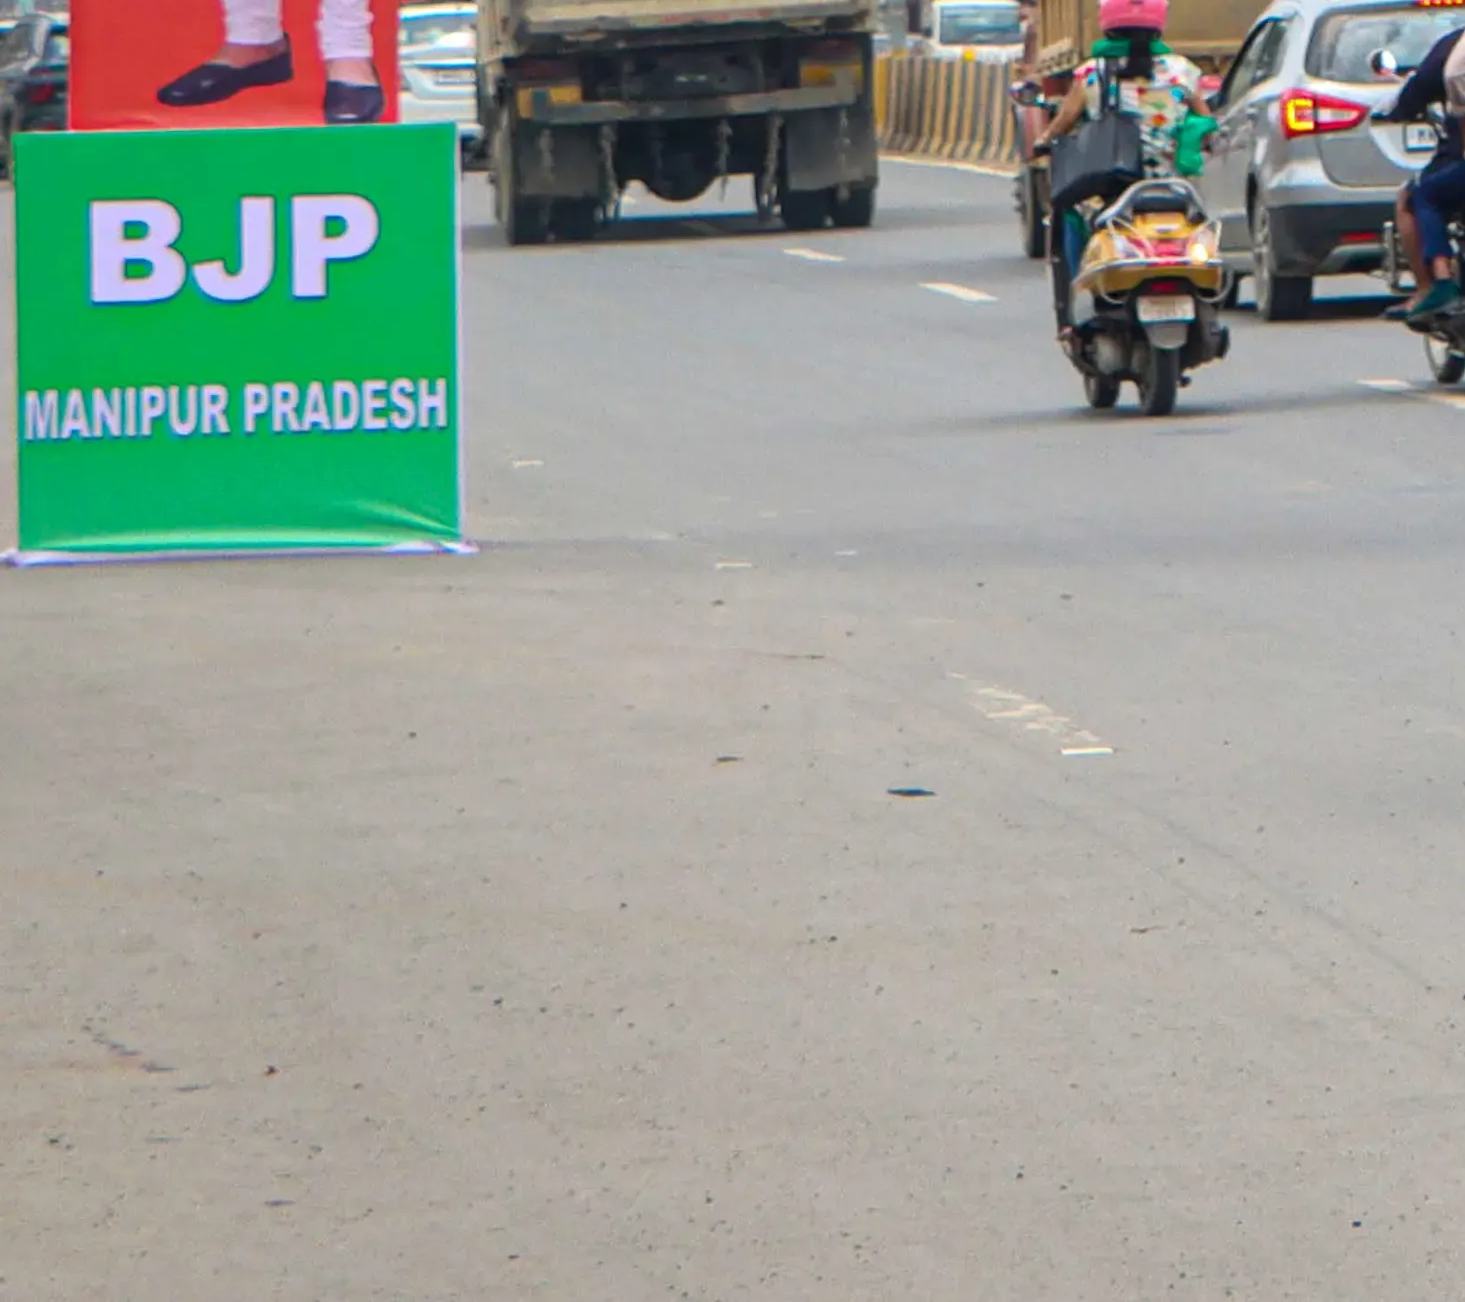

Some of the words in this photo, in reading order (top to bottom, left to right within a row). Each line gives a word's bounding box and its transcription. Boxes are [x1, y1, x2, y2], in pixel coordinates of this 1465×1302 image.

[89, 192, 381, 305] BJP
[24, 384, 230, 441] MANIPUR
[243, 377, 449, 434] PRADESH
